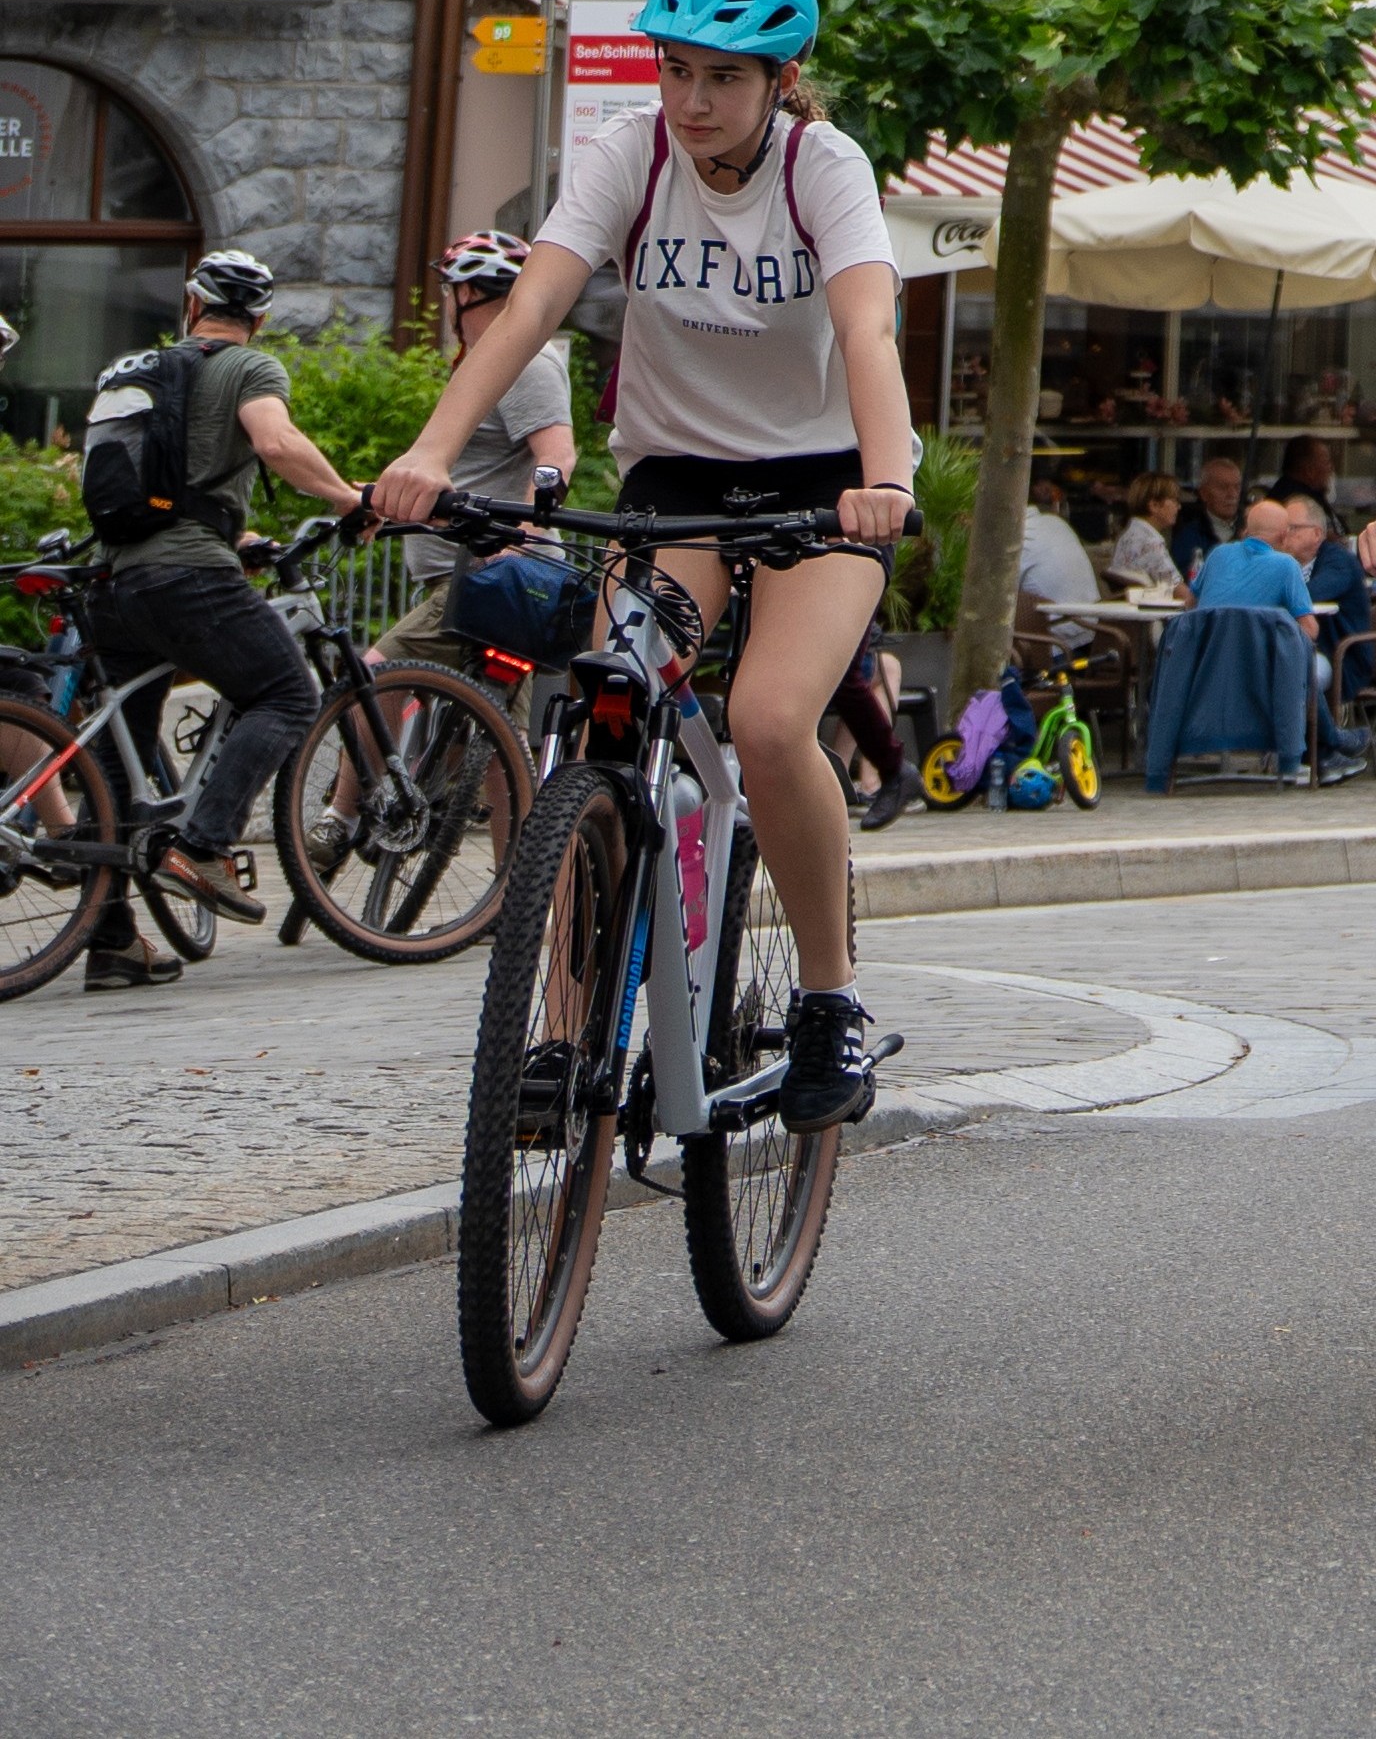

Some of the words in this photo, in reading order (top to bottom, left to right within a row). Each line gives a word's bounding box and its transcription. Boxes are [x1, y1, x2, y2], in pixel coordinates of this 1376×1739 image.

[576, 107, 596, 117] 502
[575, 136, 591, 146] 50
[682, 318, 760, 337] UNIVERSITY
